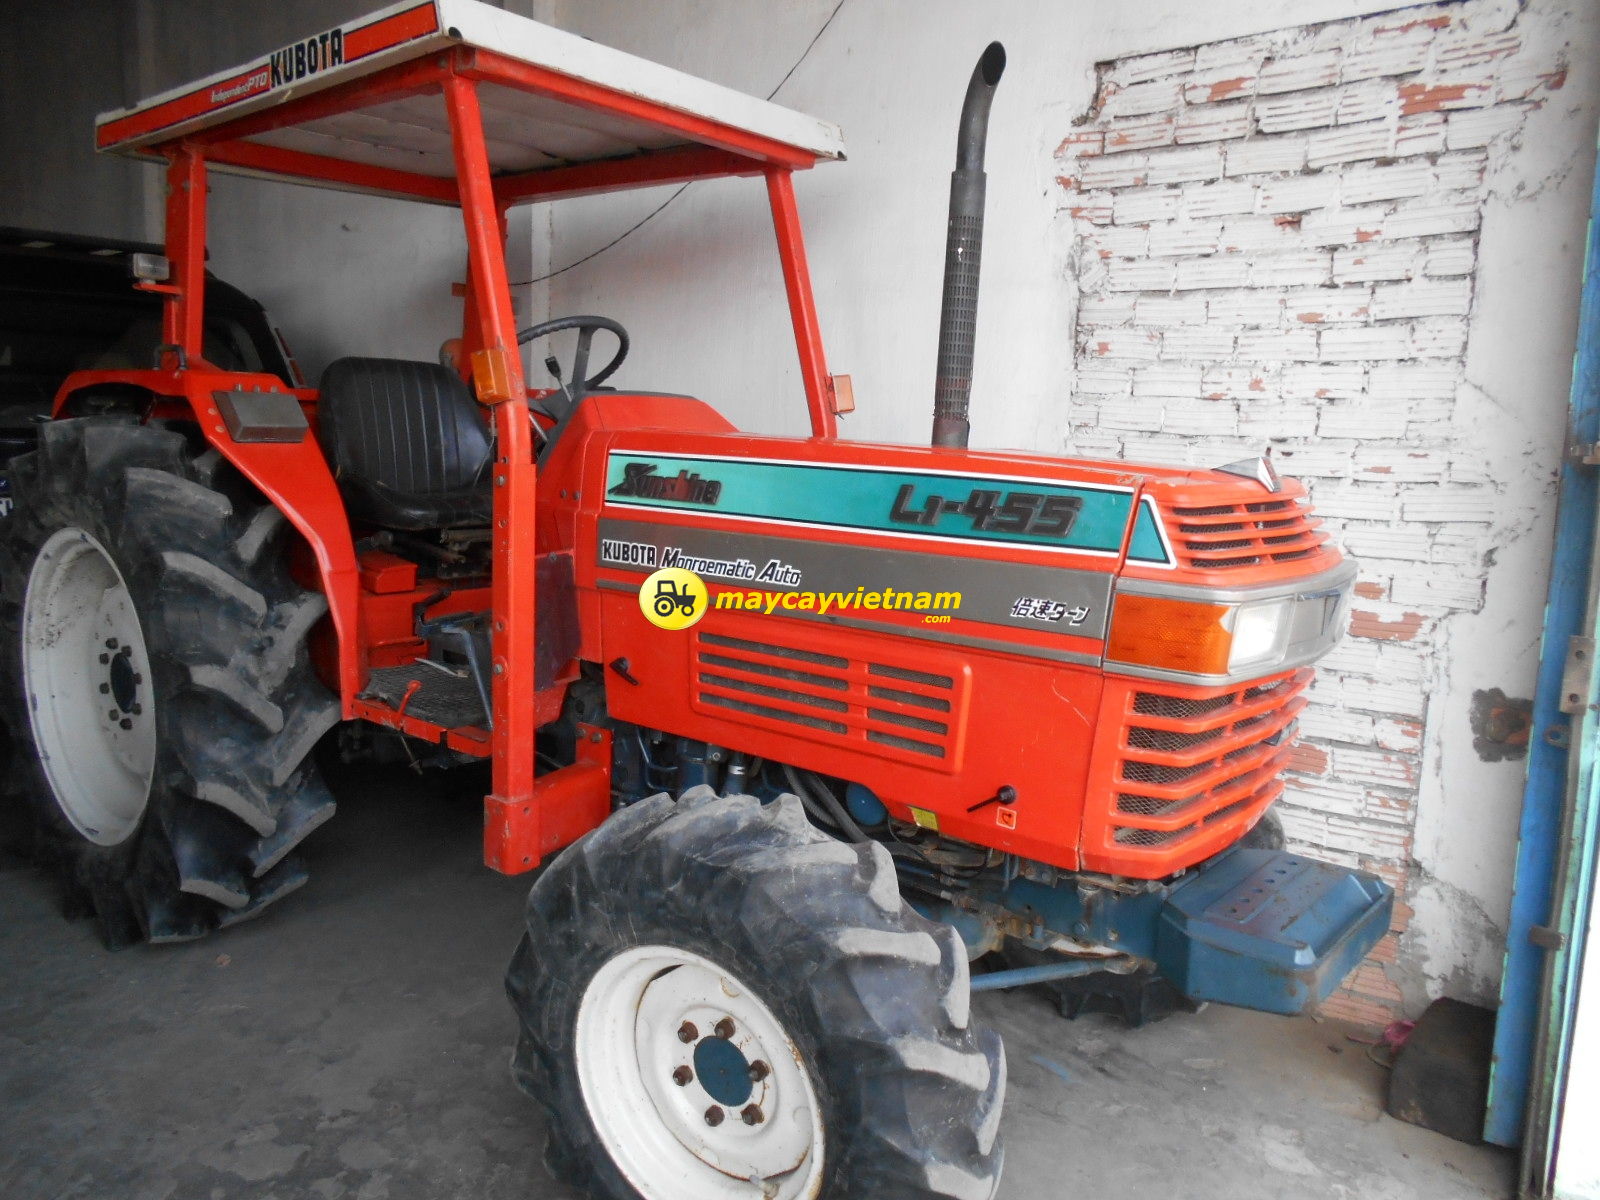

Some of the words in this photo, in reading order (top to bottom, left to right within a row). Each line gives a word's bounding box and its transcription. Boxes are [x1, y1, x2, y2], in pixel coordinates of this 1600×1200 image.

[270, 28, 343, 89] KUBOTA
[602, 540, 657, 566] KUBOTA
[661, 547, 756, 579] Monroematic
[755, 560, 801, 586] Auto
[1010, 596, 1091, 626] 倍速ターン
